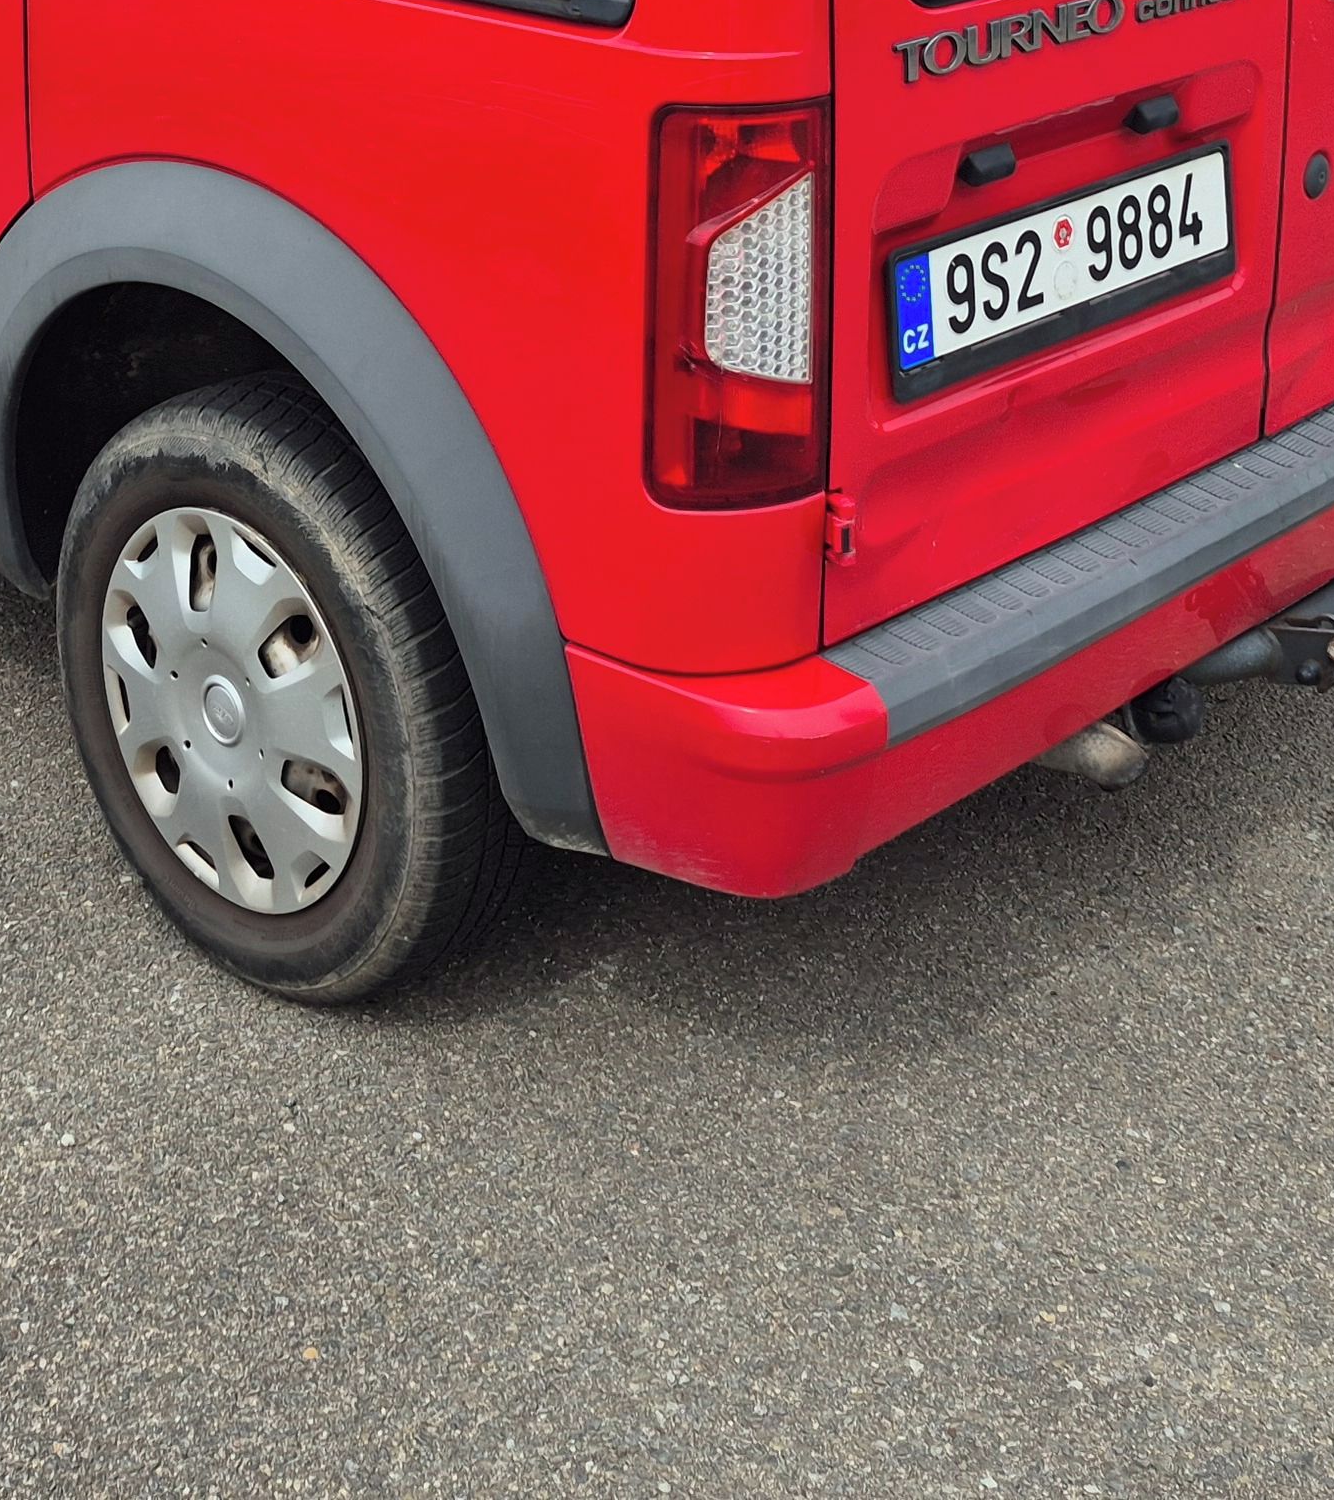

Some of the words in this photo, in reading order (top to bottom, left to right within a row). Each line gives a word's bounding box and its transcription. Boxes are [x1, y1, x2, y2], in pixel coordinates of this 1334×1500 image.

[946, 230, 1044, 334] 9S2
[1086, 173, 1202, 281] 9884
[903, 324, 929, 354] CZ
